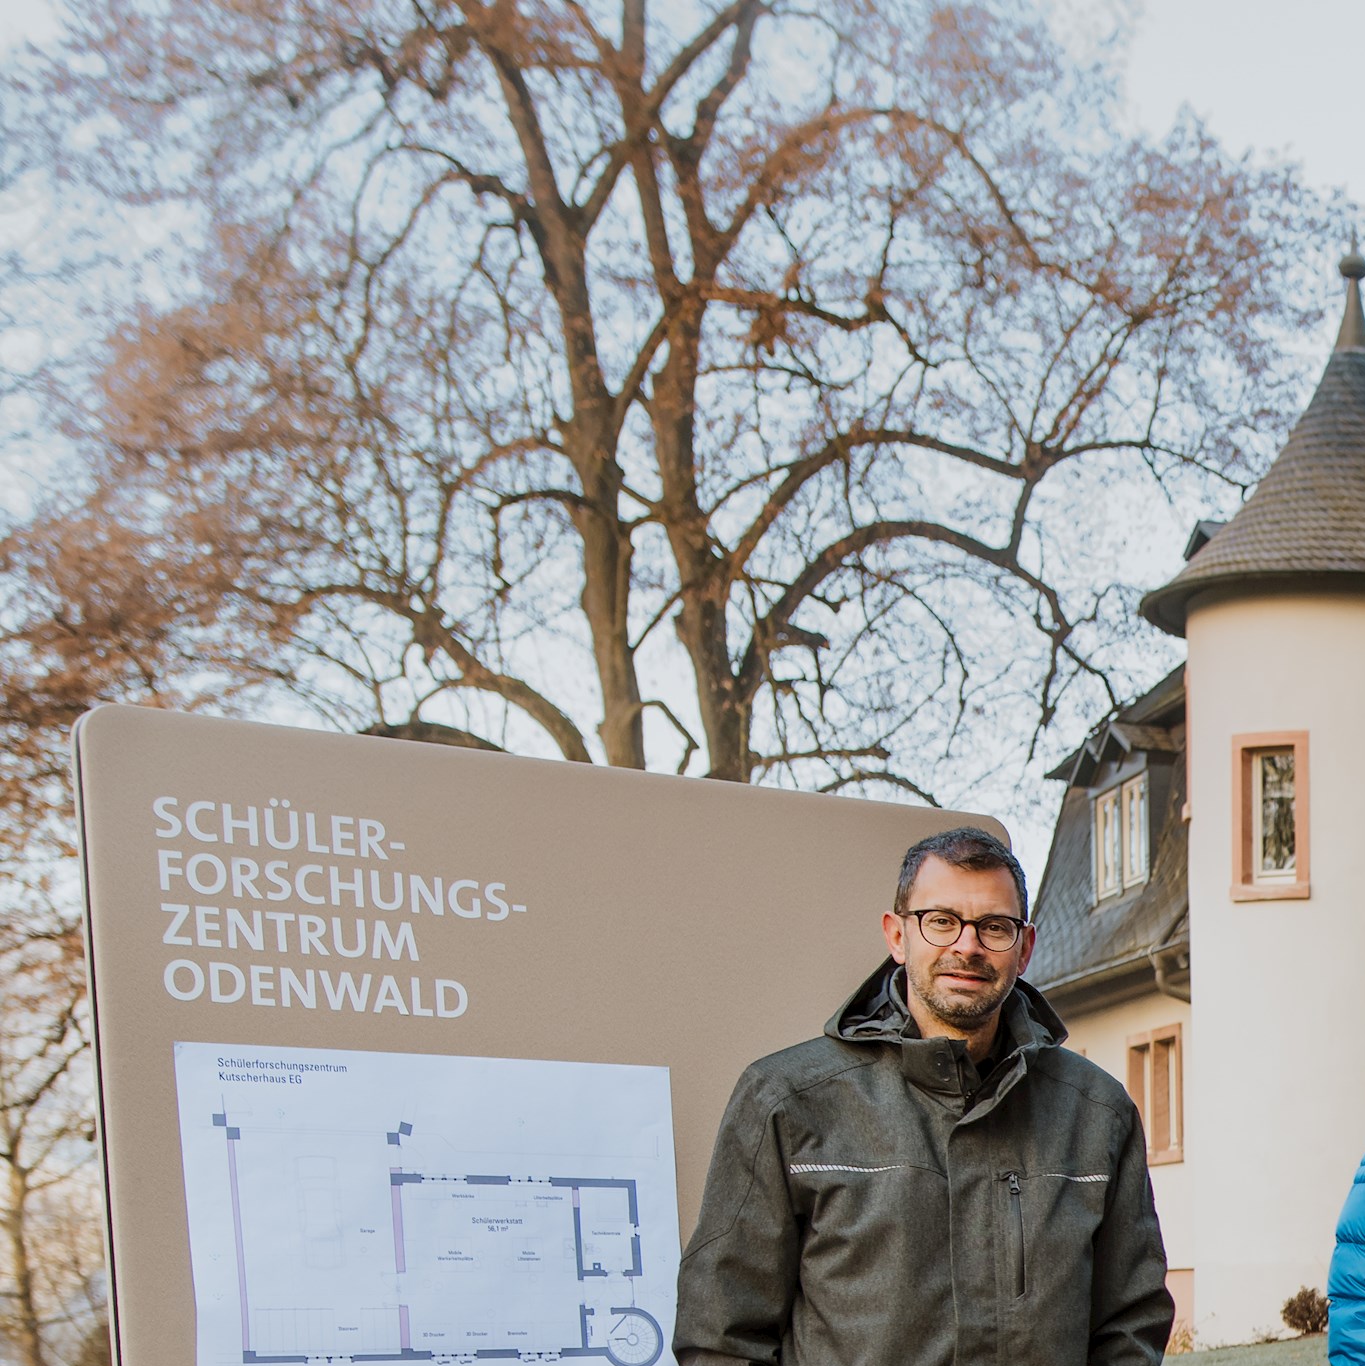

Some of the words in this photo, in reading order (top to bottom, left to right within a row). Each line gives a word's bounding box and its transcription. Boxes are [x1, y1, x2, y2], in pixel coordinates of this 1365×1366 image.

[152, 796, 406, 860] SCHÜLER-
[157, 848, 527, 921] FORSCHUNGS-
[161, 902, 420, 961] ZENTRUM
[163, 958, 469, 1019] ODENWALD
[217, 1057, 348, 1073] Schülerforschungszentrum
[218, 1072, 287, 1084] Kutscherhaus
[288, 1074, 302, 1085] EG
[471, 1216, 523, 1225] Schülerwerkstatt
